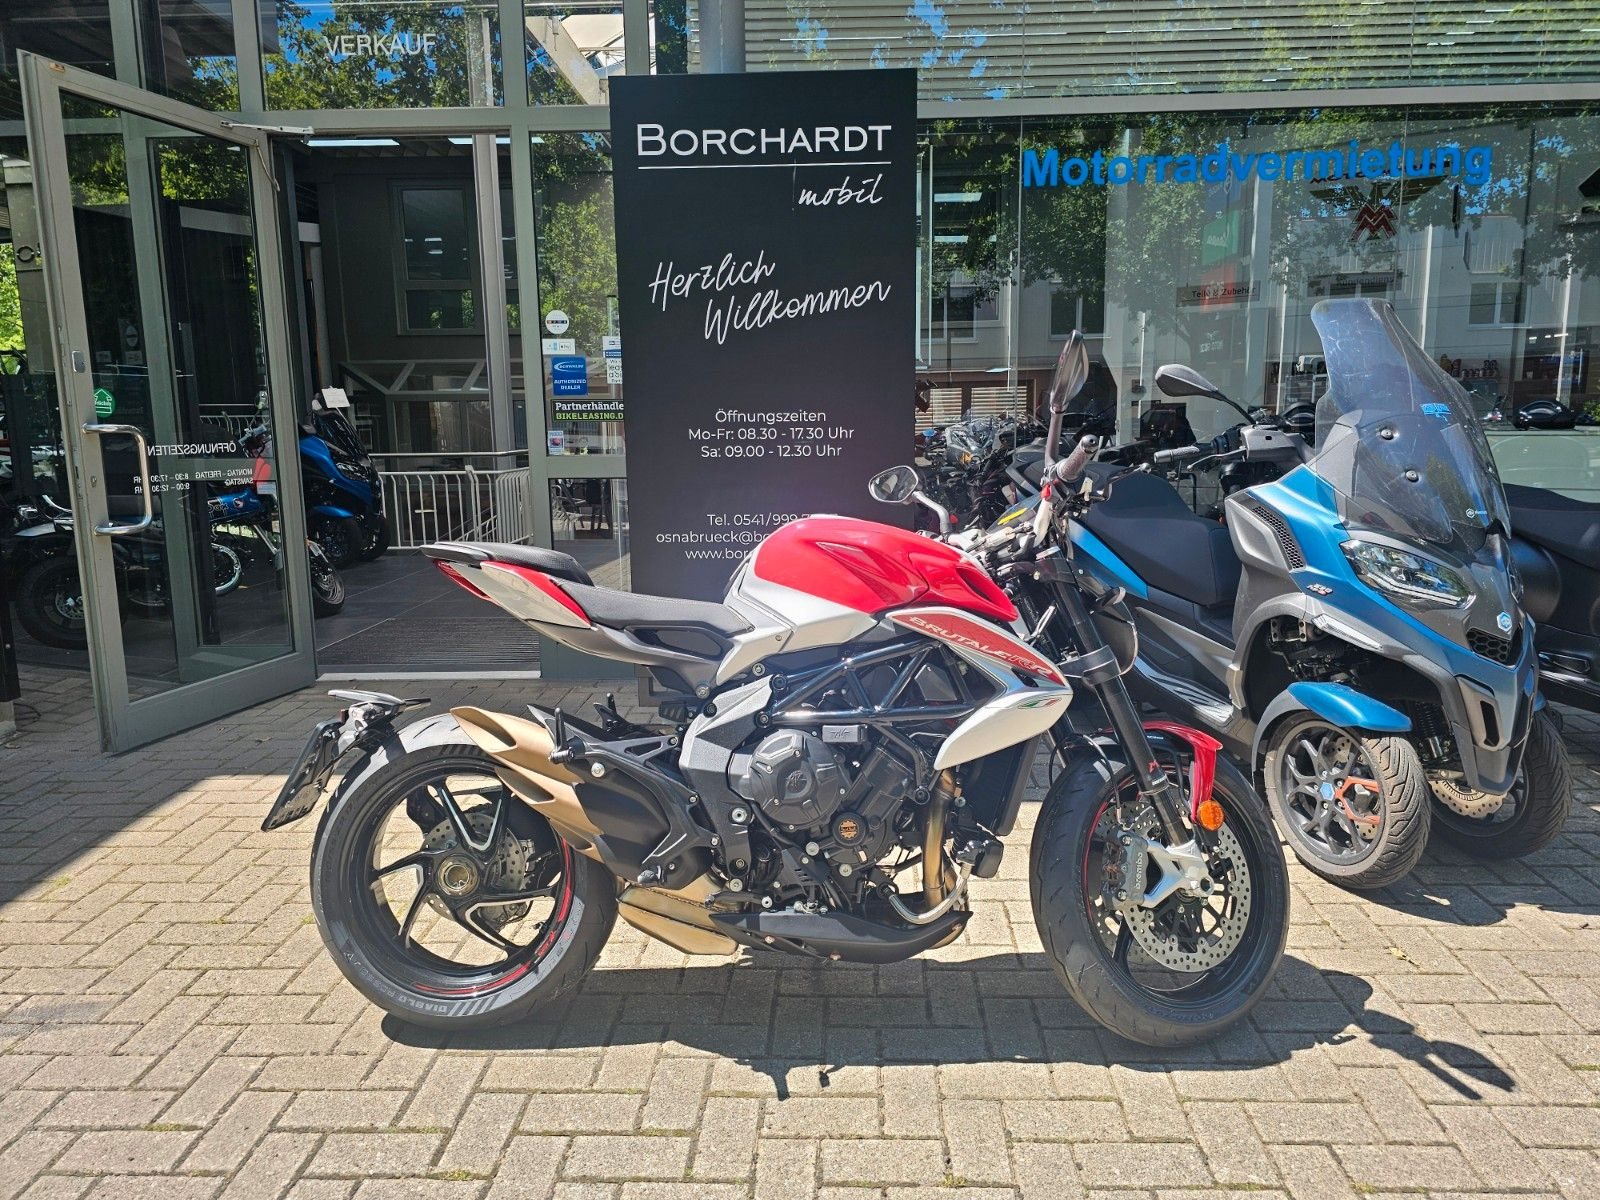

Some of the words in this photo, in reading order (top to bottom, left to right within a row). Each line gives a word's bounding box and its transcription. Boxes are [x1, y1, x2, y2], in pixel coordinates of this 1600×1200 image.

[322, 33, 437, 56] VERKAUF
[636, 123, 892, 156] BORCHARDT
[1023, 138, 1492, 187] Motorradvermietung
[798, 173, 884, 207] mobil
[648, 249, 776, 312] Herzlich
[704, 280, 892, 346] Willkommen
[555, 401, 624, 411] Partnerhändle
[556, 412, 624, 420] BIKELEASING.D
[715, 408, 827, 425] Öffnungszeiten
[688, 428, 734, 440] Mo-Fr:
[737, 428, 778, 440] 08.30
[789, 427, 824, 440] 17.30
[828, 426, 855, 440] Uhr
[701, 445, 722, 458] Sa:
[725, 445, 765, 458] 09.00
[777, 445, 812, 457] 12.30
[816, 444, 842, 457] Uhr
[706, 514, 731, 526] Tel.
[733, 513, 798, 527] 0541/999
[655, 530, 769, 545] osnabrueck@bo
[685, 547, 752, 560] www.bor
[909, 616, 1013, 660] BRUTALE
[1134, 852, 1143, 890] brembo
[398, 995, 448, 1013] DIABLO
